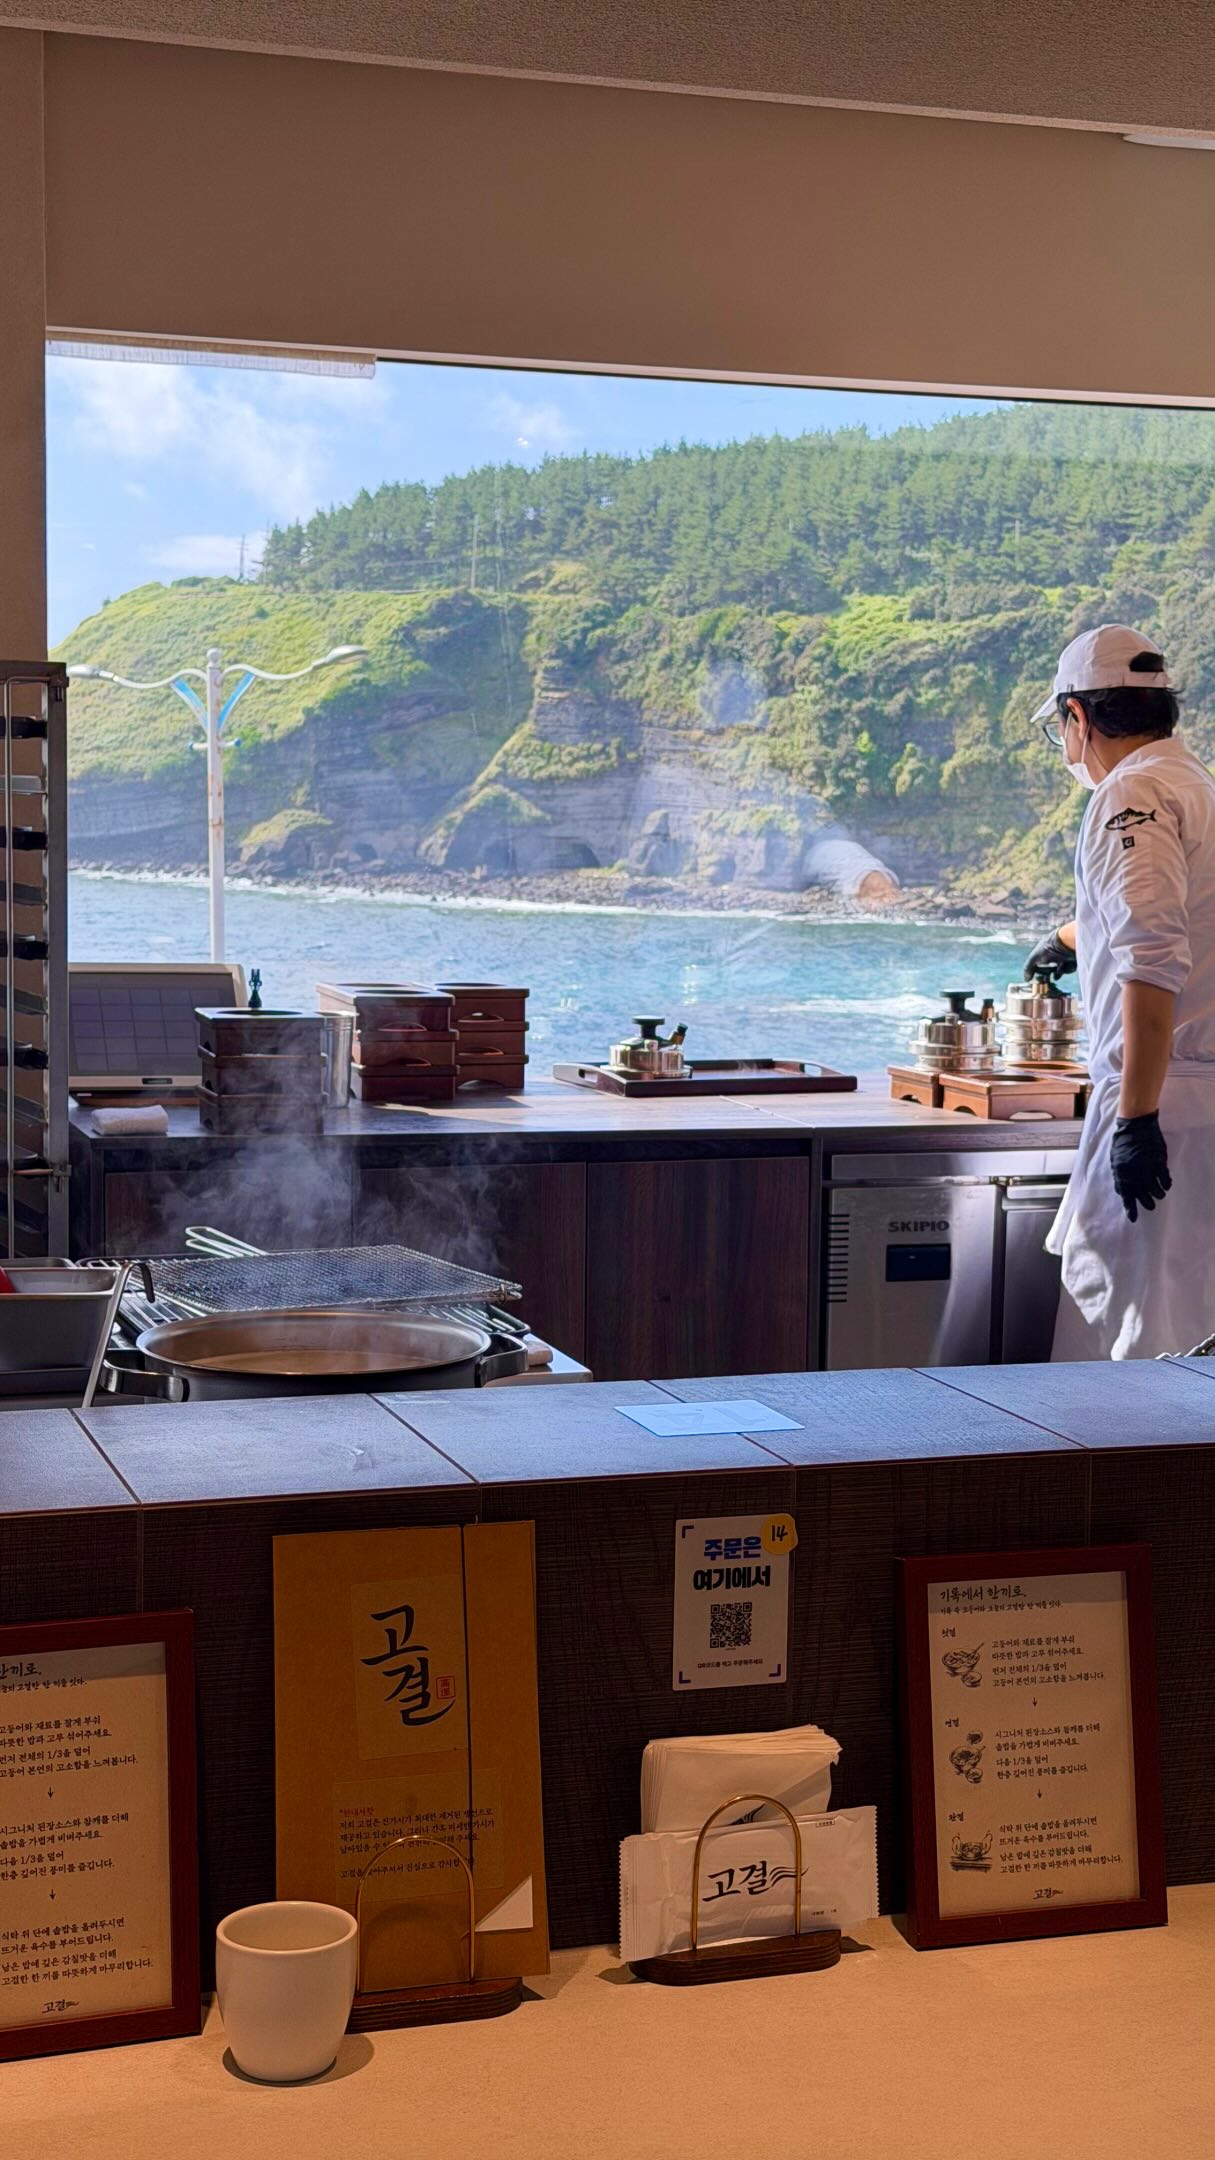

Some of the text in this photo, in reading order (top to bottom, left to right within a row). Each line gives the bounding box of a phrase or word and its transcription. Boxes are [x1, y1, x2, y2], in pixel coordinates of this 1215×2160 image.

[888, 1220, 950, 1233] SKIPIO
[770, 1525, 789, 1542] 14
[703, 1536, 761, 1561] 주문은
[692, 1566, 771, 1591] 여기에서
[940, 1586, 983, 1602] 기록에서
[361, 1603, 456, 1727] 고결
[1032, 1663, 1050, 1673] 1/3을
[0, 1722, 32, 1735] 고등어와
[36, 1720, 61, 1730] 재료를
[64, 1717, 82, 1728] 잘게
[996, 1728, 1023, 1739] 시그니처
[0, 1736, 24, 1749] 따뜻한
[27, 1734, 44, 1746] 밥과
[47, 1733, 64, 1743] 고루
[0, 1745, 90, 1766] 먼저 전체의 1/3을 덜어
[996, 1758, 1010, 1767] 다음
[1014, 1756, 1032, 1766] 1/3을
[0, 1766, 24, 1779] 고등어
[56, 1760, 91, 1772] 고소함을
[0, 1823, 34, 1836] 시그니처
[38, 1818, 81, 1832] 된장소스와
[112, 1812, 128, 1823] 더해
[0, 1838, 25, 1850] 솥밥을
[29, 1834, 55, 1847] 가볍게
[0, 1850, 64, 1868] 다음 1/3을 덜어
[0, 1858, 114, 1882] 한층 깊어진 풍미를 즐깁니다.
[702, 1860, 771, 1903] 고결
[1032, 1887, 1054, 1900] 고결
[1, 1917, 124, 1942] 식탁 위 단에 솥밥을 올려두시면
[1, 1933, 113, 1956] 뜨거운 육수를 부어드립니다.
[1, 1948, 116, 1974] 남은 밥에 깊은 감칠맛을 더해
[1, 1974, 28, 1987] 고결한
[32, 1972, 40, 1983] 한
[62, 1965, 97, 1979] 따뜻하게
[99, 1958, 154, 1974] 마무리합니다.
[41, 1999, 67, 2014] 고결
